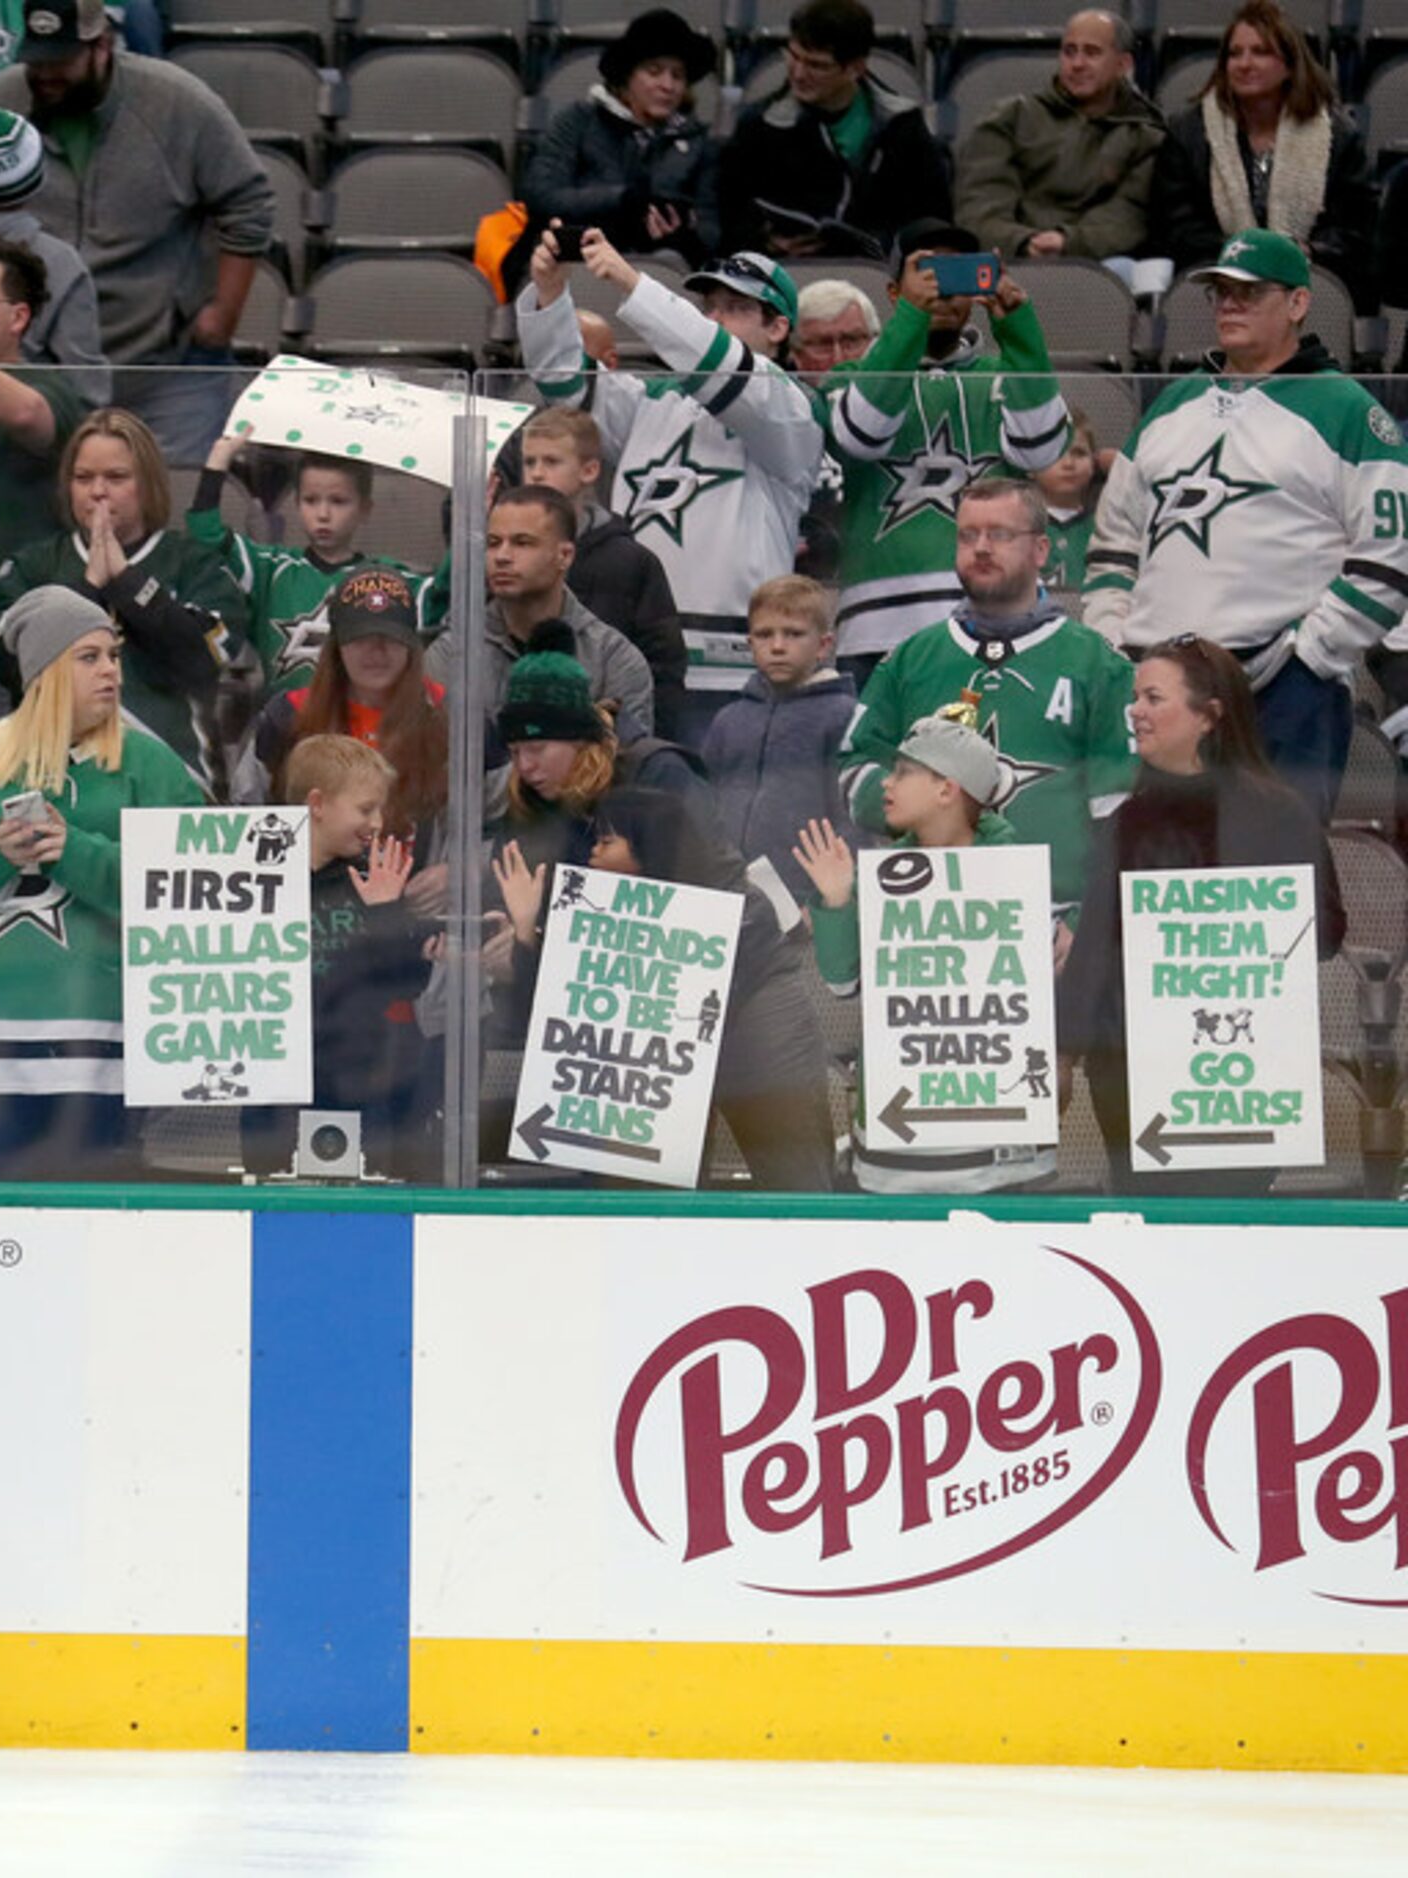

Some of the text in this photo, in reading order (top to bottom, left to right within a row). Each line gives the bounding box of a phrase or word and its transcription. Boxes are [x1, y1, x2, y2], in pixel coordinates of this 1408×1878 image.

[1044, 676, 1073, 726] A
[176, 813, 249, 855] MY
[145, 869, 284, 914] FIRST
[945, 852, 962, 891] I
[610, 879, 677, 919] MY
[1132, 876, 1297, 914] RAISING
[568, 910, 728, 970] FRIENDS
[879, 899, 1024, 941] MADE
[1158, 921, 1268, 957] THEM
[128, 922, 310, 966] DALLAS
[876, 945, 1027, 987] HER A
[149, 971, 293, 1015] STARS
[577, 950, 682, 997] HAVE
[1152, 961, 1285, 998] RIGHT!
[565, 983, 676, 1034] TO BE
[887, 993, 1029, 1027] DALLAS
[144, 1019, 287, 1064] GAME
[542, 1017, 696, 1076] DALLAS
[900, 1033, 1013, 1066] STARS
[551, 1058, 674, 1111] STARS
[918, 1071, 997, 1106] FAN
[1189, 1052, 1255, 1087] GO
[555, 1094, 655, 1144] FANS
[1170, 1091, 1303, 1125] STARS!
[805, 1268, 995, 1421] Dr
[615, 1304, 1120, 1563] Pepper
[1186, 1313, 1408, 1572] Pe
[943, 1449, 1071, 1518] Est.1885
